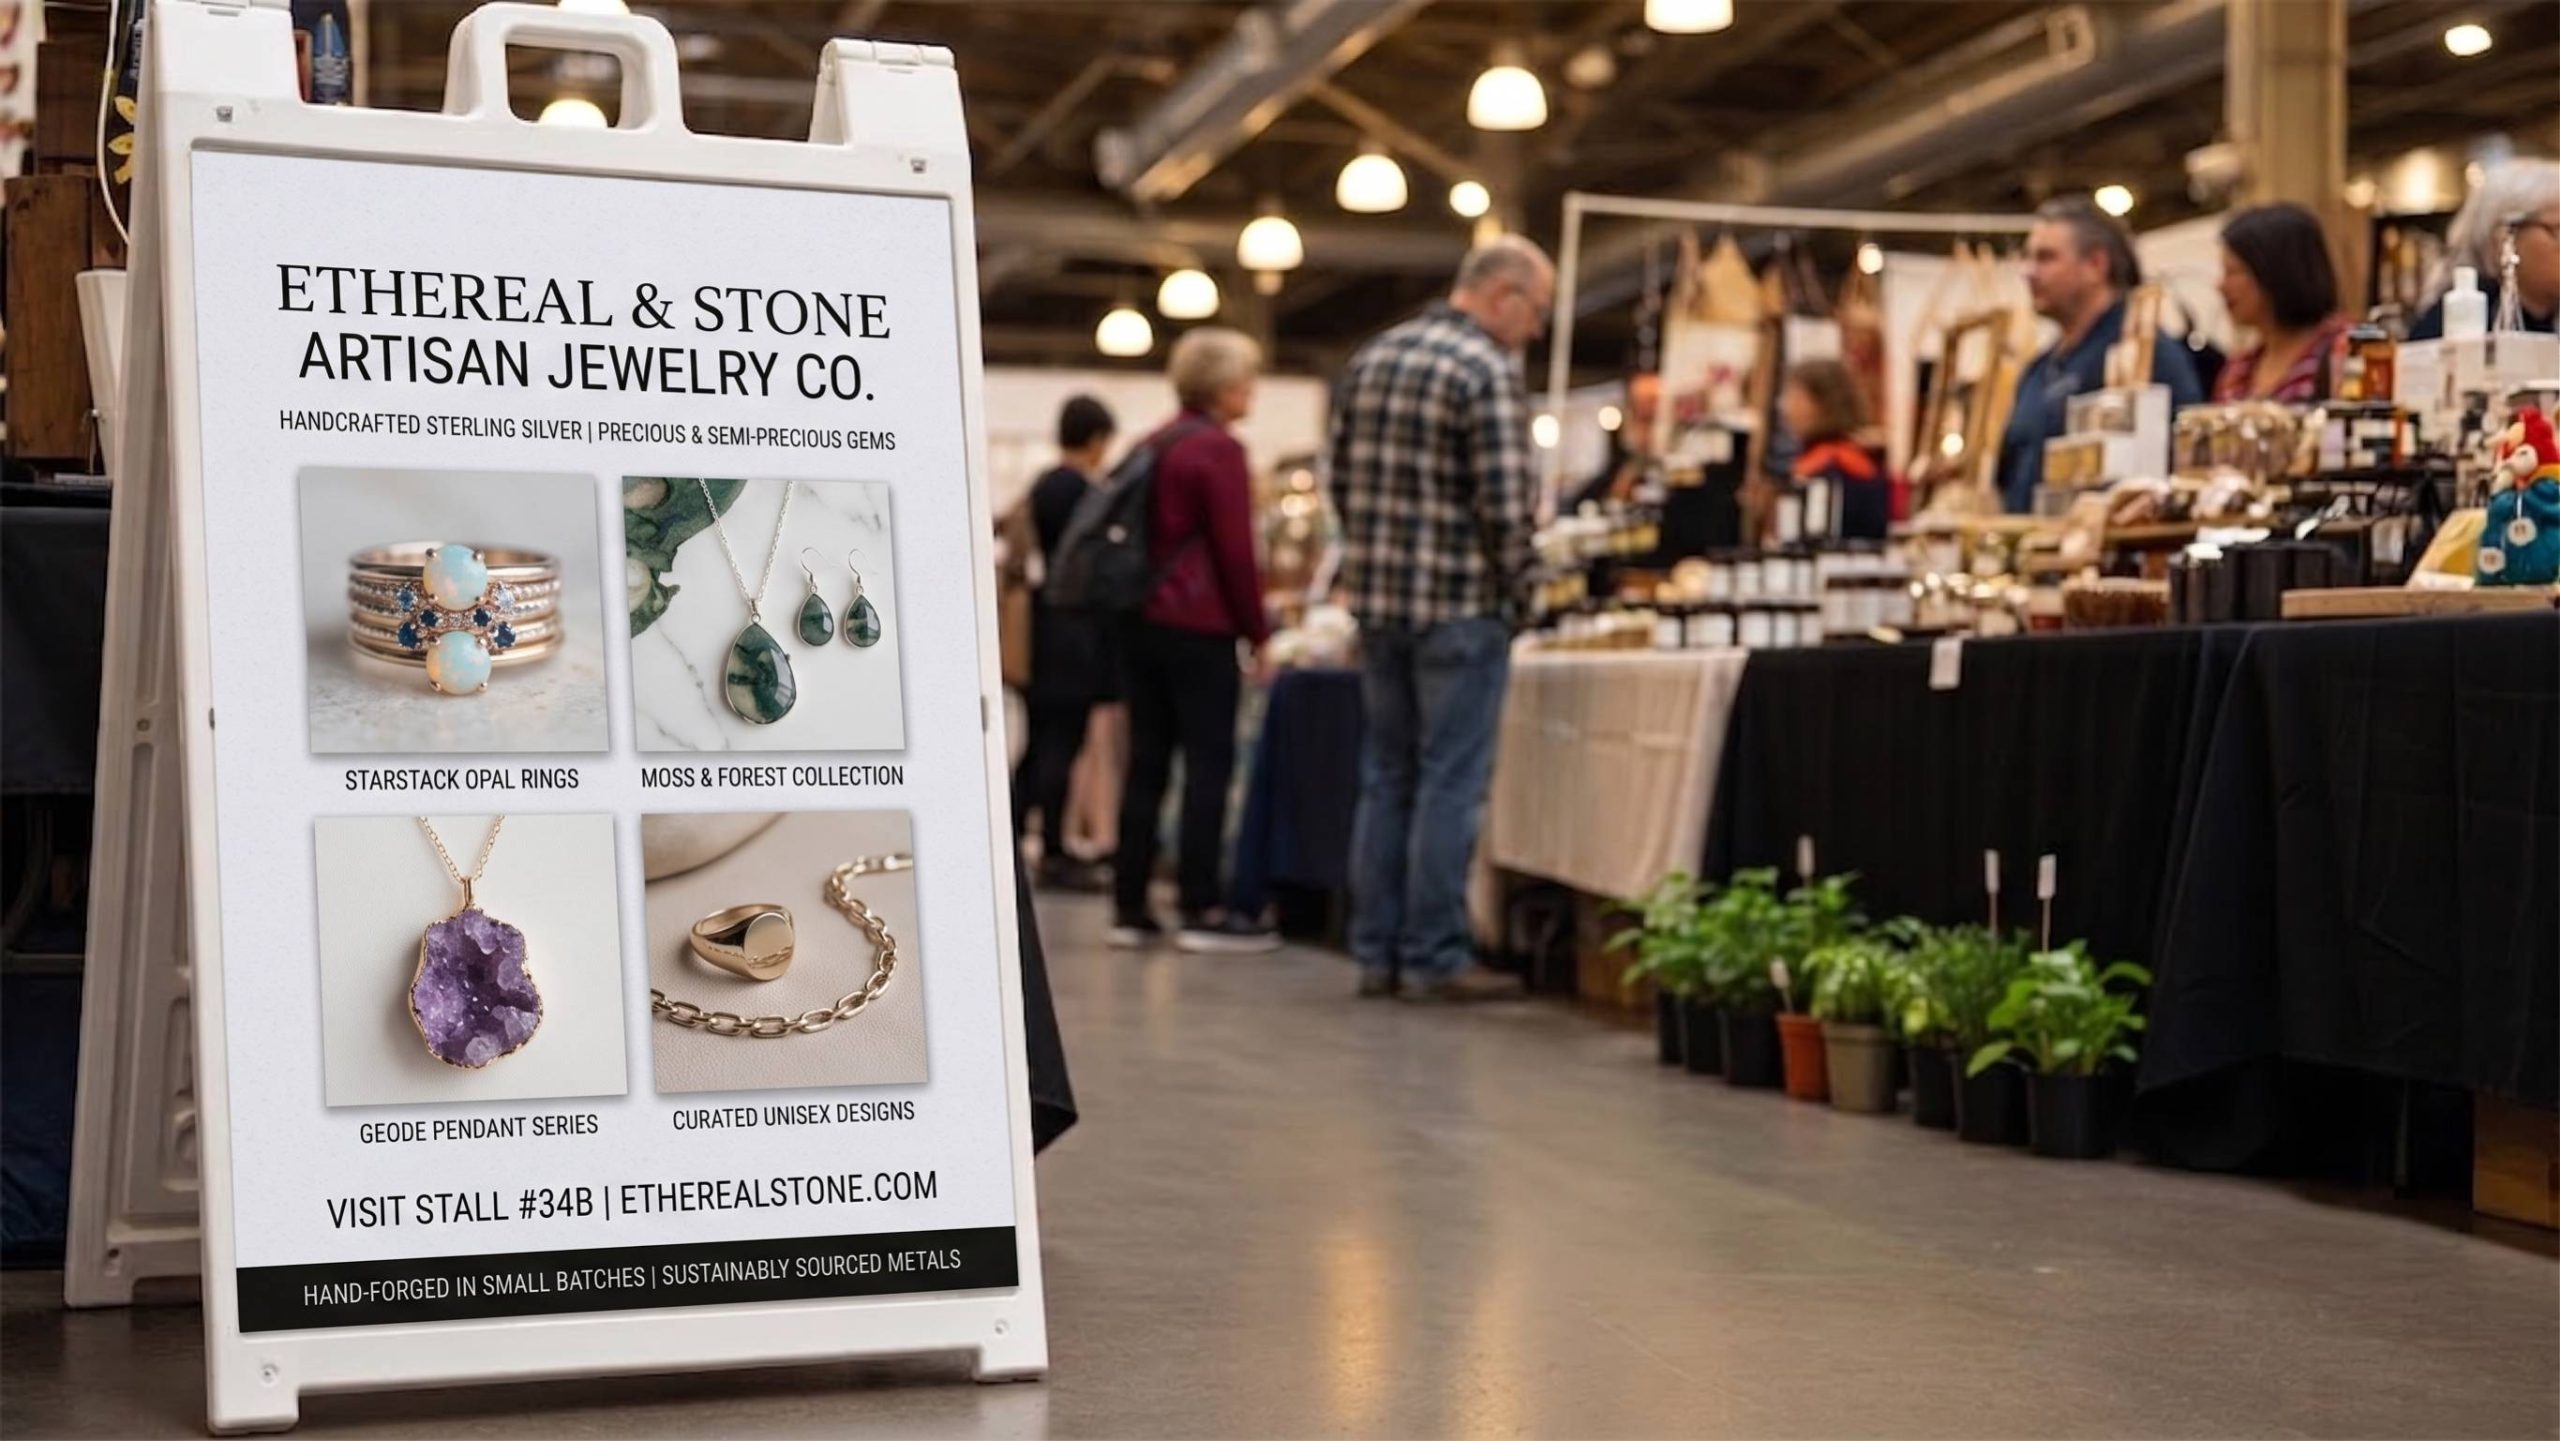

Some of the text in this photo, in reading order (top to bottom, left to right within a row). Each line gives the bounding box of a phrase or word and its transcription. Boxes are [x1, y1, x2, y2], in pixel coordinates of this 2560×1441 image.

[276, 263, 891, 339] ETHEREAL & STONE
[298, 331, 874, 401] ARTISAN JEWELRY CO.
[280, 409, 421, 435] HANDCRAFTED
[426, 415, 516, 438] STERLING
[521, 418, 583, 440] SILVER
[598, 421, 686, 444] PRECIOUS
[691, 425, 703, 445] &
[707, 425, 842, 449] SEMI-PRECIOUS
[846, 430, 896, 451] GEMS
[345, 768, 579, 791] STARSTACK OPAL RINGS
[641, 765, 904, 788] MOSS & FOREST COLLECTION
[360, 1113, 599, 1144] GEODE PENDANT SERIES
[672, 1100, 915, 1131] CURATED UNISEX DESIGNS
[326, 1195, 406, 1229] VISIT
[415, 1190, 510, 1225] STALL
[518, 1186, 593, 1220] #34B
[620, 1170, 937, 1215] ETHEREALSTONE.COM
[304, 1277, 449, 1306] HAND-FORGED
[456, 1276, 476, 1297] IN
[483, 1272, 551, 1296] SMALL
[556, 1266, 645, 1292] BATCHES
[662, 1258, 790, 1286] SUSTAINABLY
[795, 1253, 882, 1278] SOURCED
[888, 1248, 961, 1272] METALS
